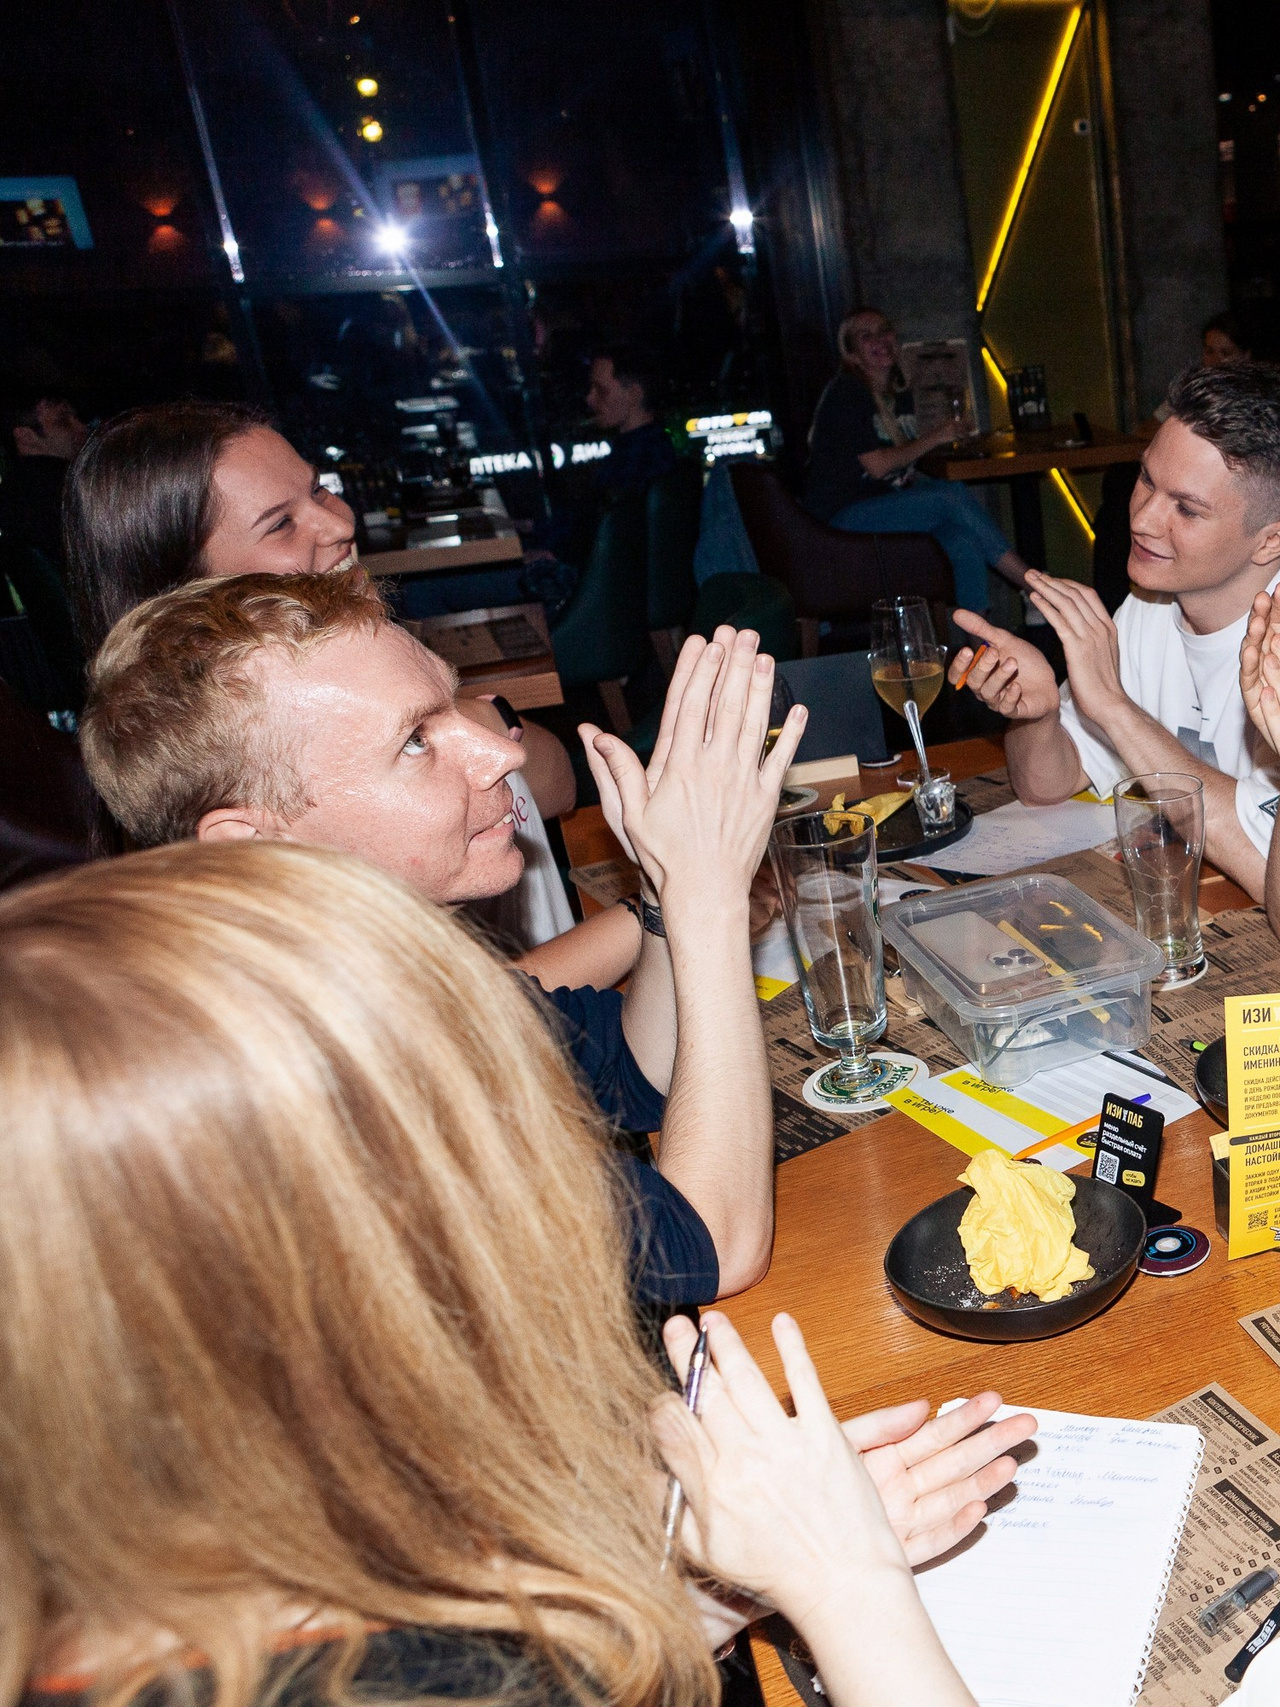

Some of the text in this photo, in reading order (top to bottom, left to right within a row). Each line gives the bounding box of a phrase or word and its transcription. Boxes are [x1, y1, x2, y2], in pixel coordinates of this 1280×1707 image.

[1242, 1007, 1270, 1024] ИЗИ
[1243, 1044, 1279, 1056] СКИДКА
[1243, 1077, 1264, 1086] СКИДКА
[1249, 1094, 1270, 1102] НЕДЕЛЮ
[912, 1101, 943, 1115] игре!
[1105, 1101, 1143, 1128] ИЗИ ПАБ
[1103, 1121, 1118, 1132] меню
[1101, 1136, 1123, 1152] быстрая
[1123, 1146, 1141, 1159] оплата
[1102, 1130, 1134, 1148] раздельный
[1134, 1142, 1147, 1153] счёт
[1245, 1171, 1265, 1179] ЗАКАЖИ
[1245, 1179, 1262, 1187] ВТОРАЯ
[1255, 1189, 1278, 1199] НАСТОЙКИ
[1205, 1397, 1229, 1415] КОКТЕЙЛИ
[1225, 1413, 1259, 1441] КЛАССИЧЕСКИЕ
[1257, 1456, 1276, 1472] МОХИТО
[1244, 1464, 1272, 1486] МИЛК ШЕЙК
[1204, 1486, 1221, 1499] ДЖИН
[1222, 1502, 1242, 1518] МАЛИНЕ
[1241, 1518, 1260, 1533] МЯТОЙ
[1222, 1489, 1274, 1532] ДОМАШНИЕ НАСТОЙКИ
[1247, 1544, 1259, 1555] 245р
[1166, 1621, 1192, 1645] РЕПОСАДО
[1175, 1616, 1213, 1654] ТЕКИЛА ЭСПОЛОН
[1156, 1629, 1202, 1674] САМОГОН КОСОГОРОВ
